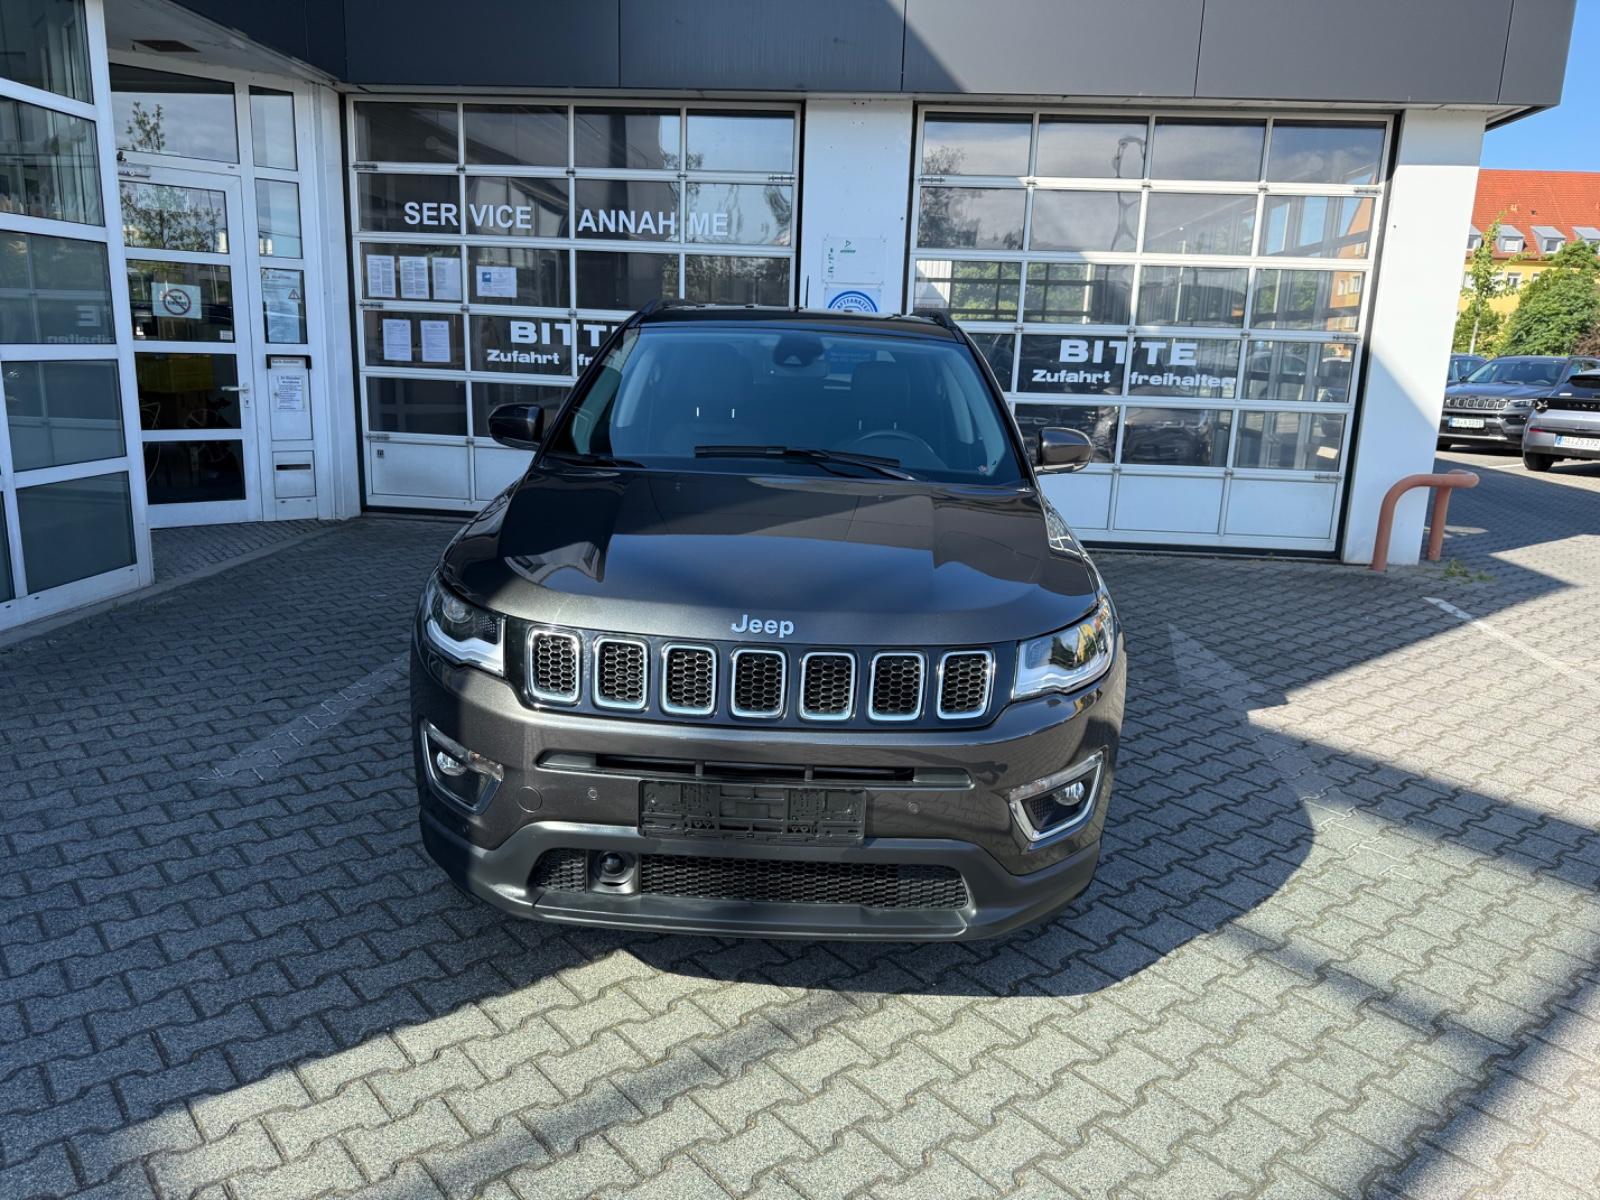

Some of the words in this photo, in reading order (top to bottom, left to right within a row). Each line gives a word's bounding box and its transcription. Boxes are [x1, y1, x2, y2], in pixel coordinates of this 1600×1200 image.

[404, 201, 532, 229] SERVICE
[577, 208, 728, 236] ANNAHME
[510, 320, 619, 347] BITT
[487, 349, 560, 365] Zufahrt
[1059, 338, 1199, 366] BITTE
[1032, 369, 1111, 385] Zufahrt
[1129, 372, 1236, 388] freihalten
[731, 614, 794, 639] Jeep
